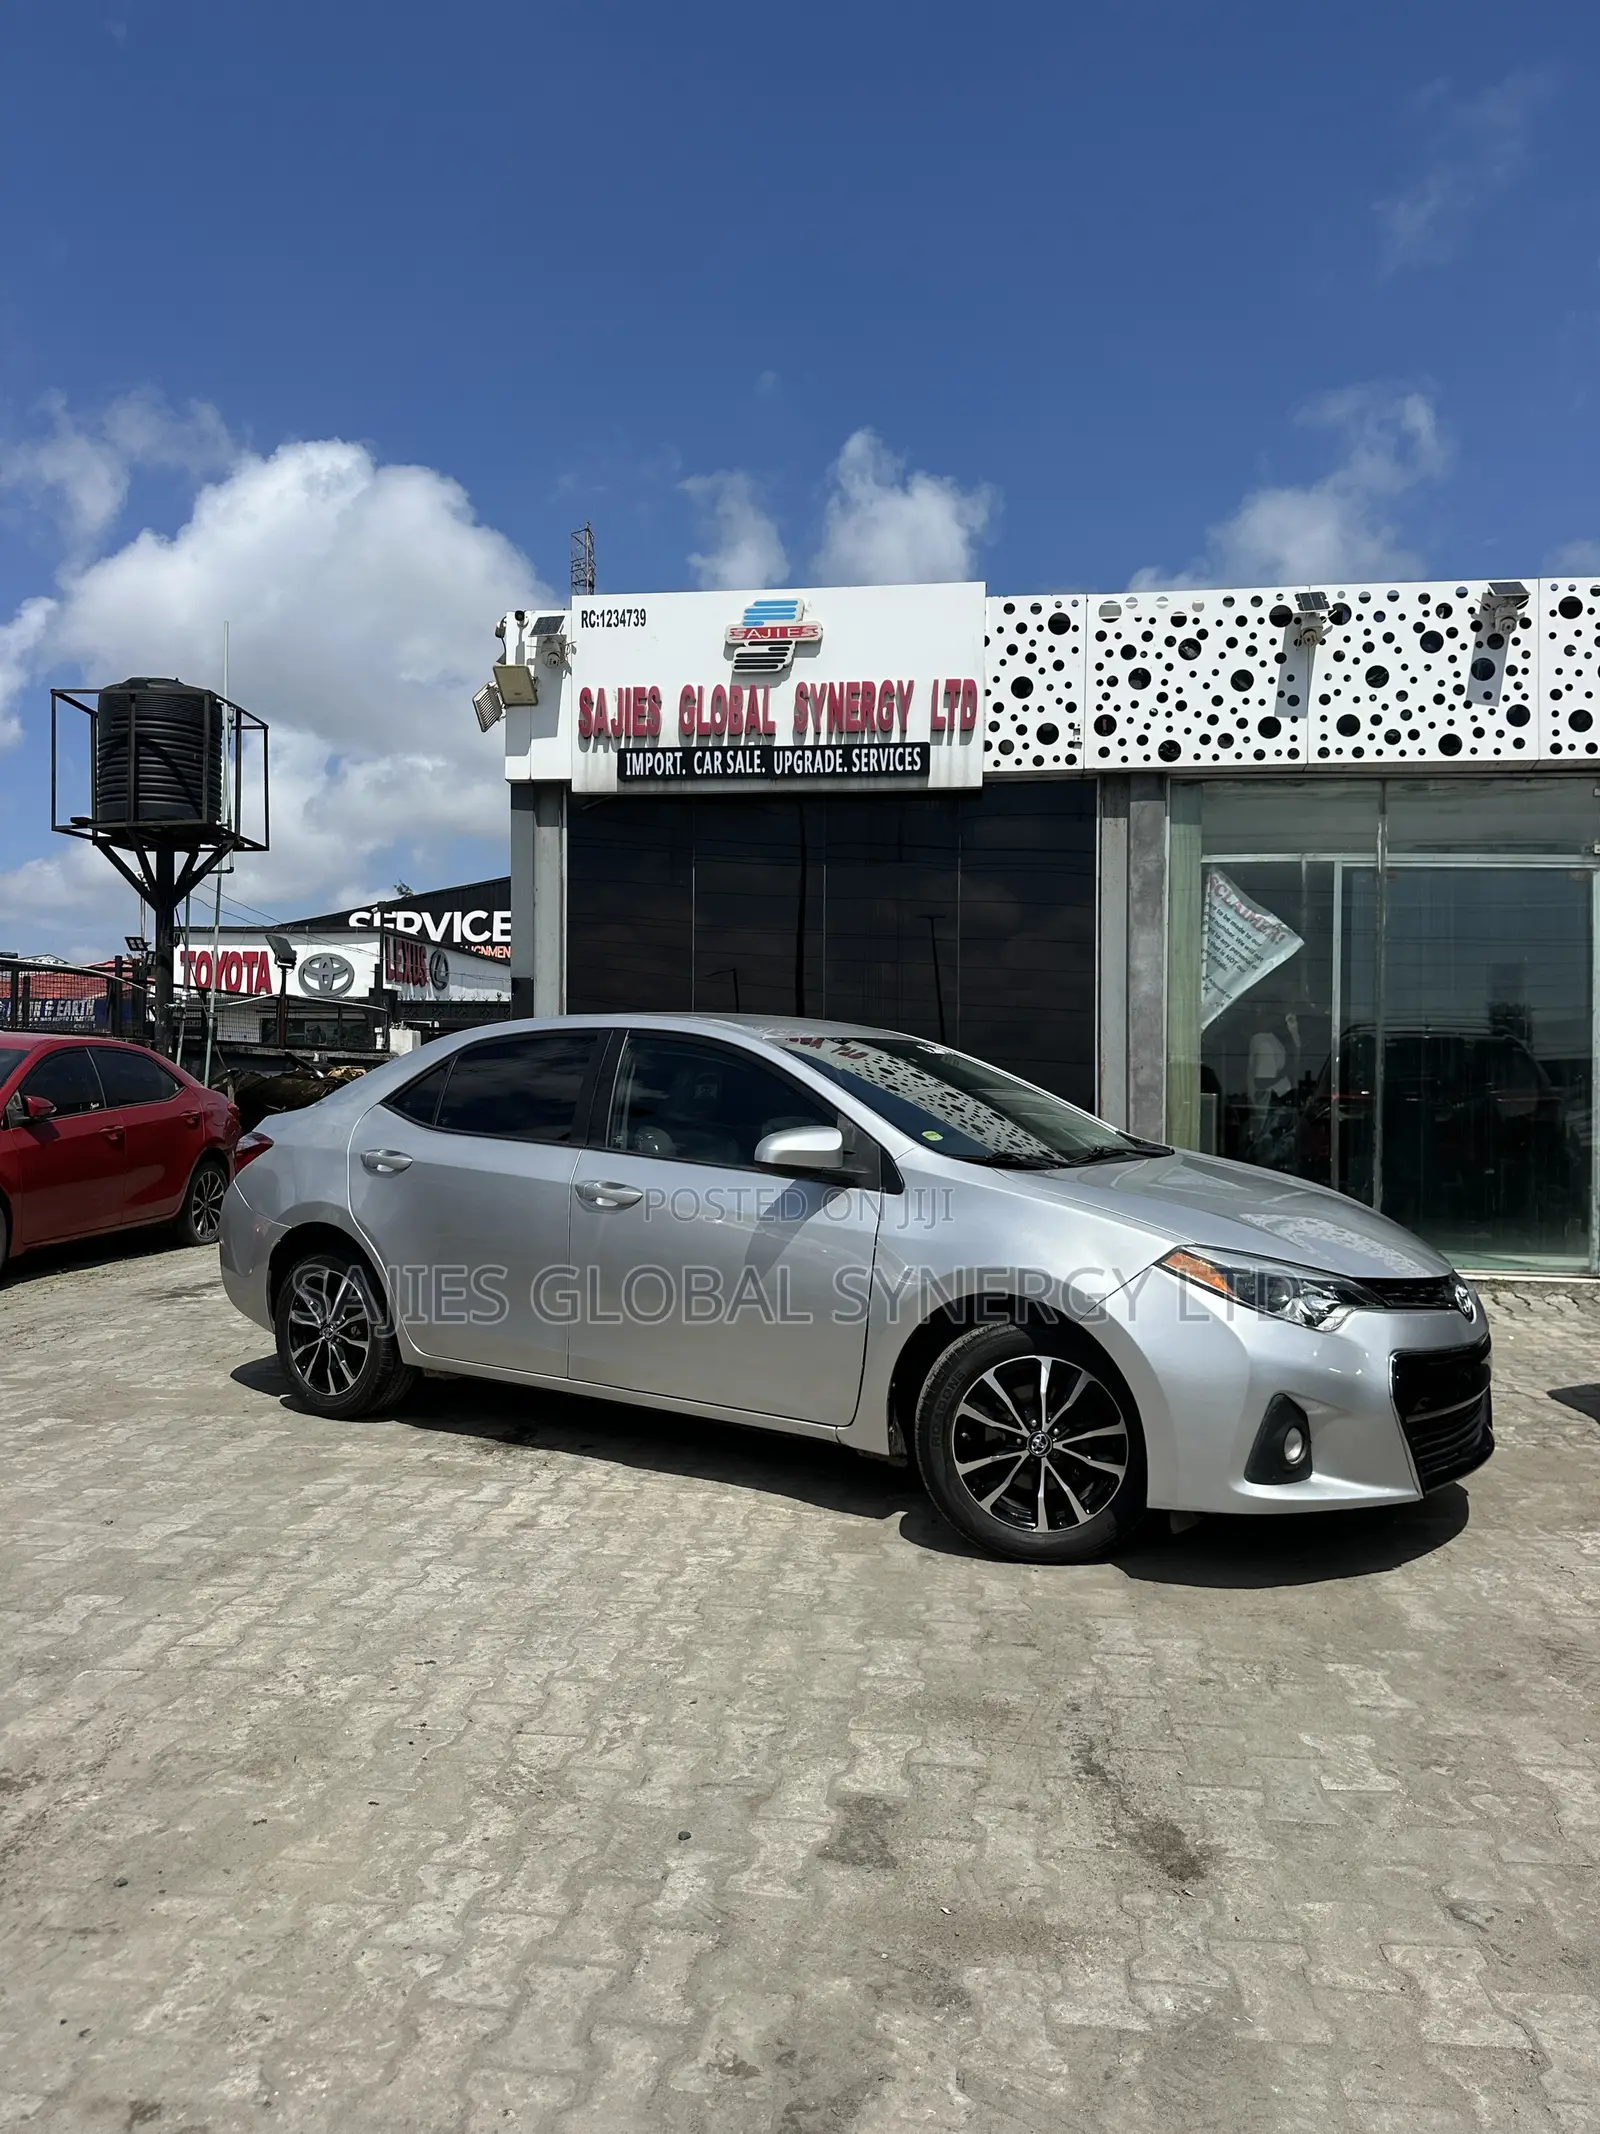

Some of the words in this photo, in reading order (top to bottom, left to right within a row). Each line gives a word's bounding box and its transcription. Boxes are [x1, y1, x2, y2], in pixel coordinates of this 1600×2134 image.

[581, 608, 646, 628] RC:1234739
[729, 625, 820, 640] SAJIES
[578, 686, 662, 738] SAJIES
[679, 683, 776, 736] GLOBAL
[793, 679, 914, 734] SYNERGY
[930, 678, 978, 732] LTD
[626, 751, 686, 776] IMPORT.
[693, 752, 723, 774] CAR
[726, 750, 766, 774] SALE.
[773, 749, 848, 775] UPGRADE.
[852, 747, 921, 772] SERVICES
[180, 951, 272, 994] TOYOTA
[385, 936, 428, 988] LEXUS
